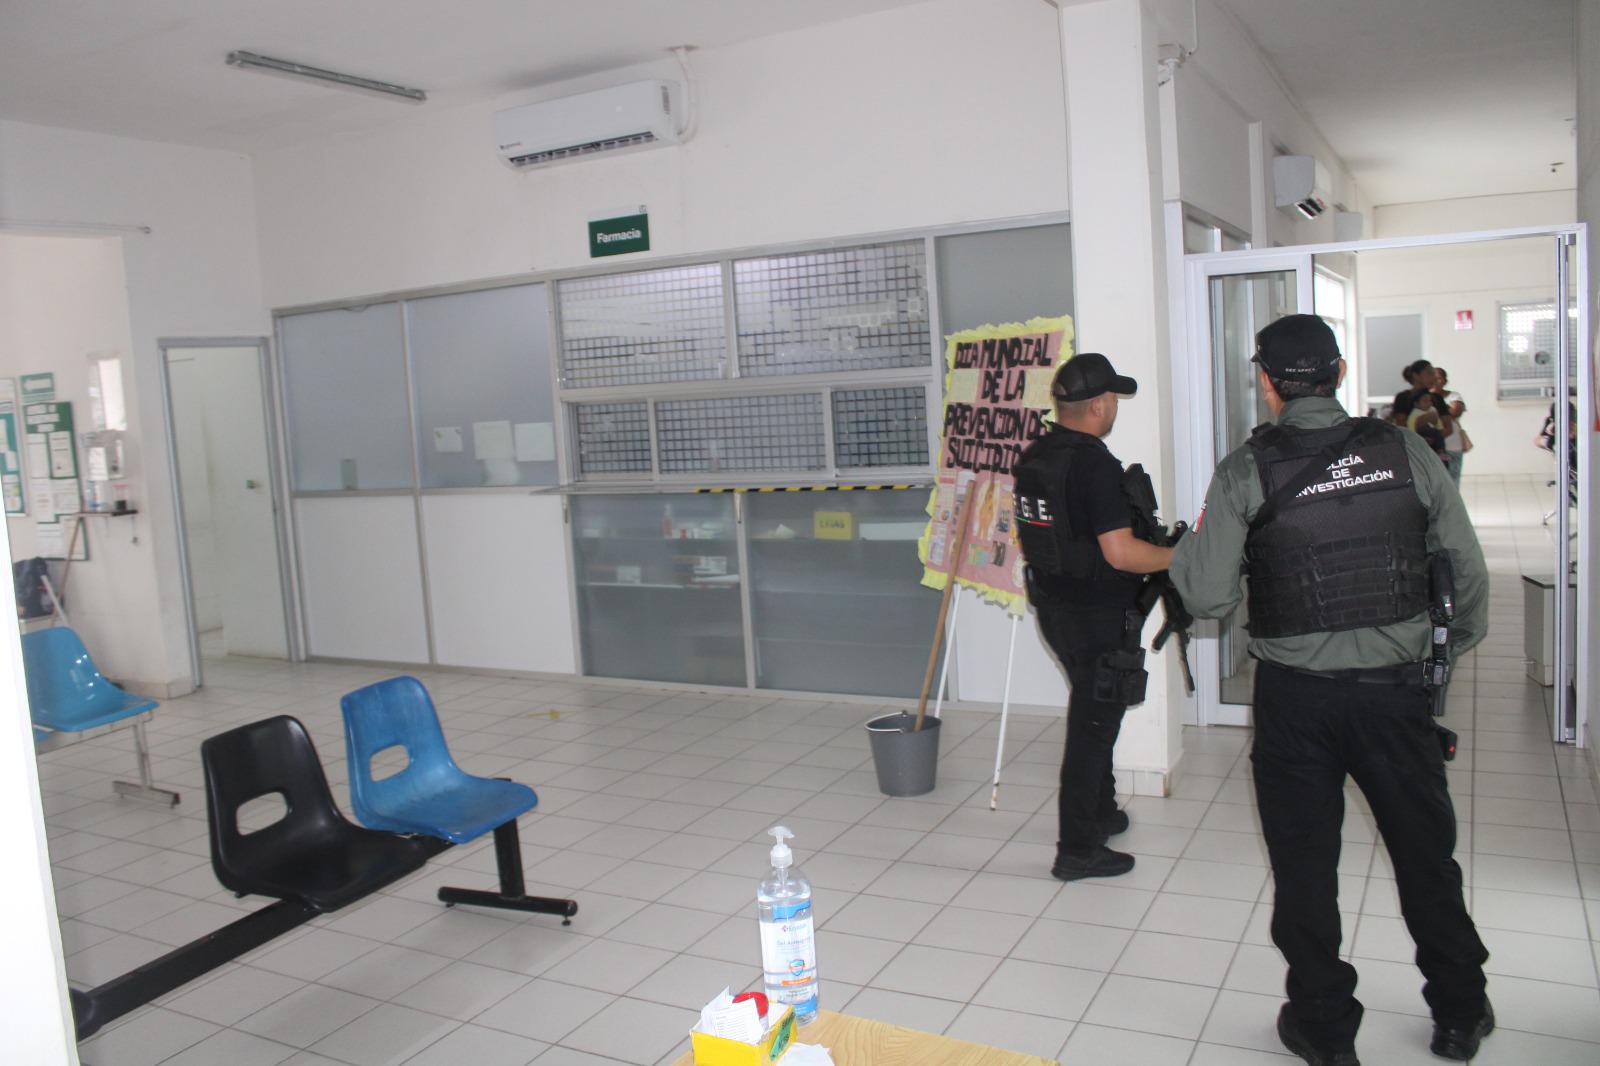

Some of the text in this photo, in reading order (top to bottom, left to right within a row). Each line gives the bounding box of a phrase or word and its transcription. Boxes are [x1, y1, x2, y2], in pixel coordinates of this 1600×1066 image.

[597, 229, 641, 244] Farmacia
[954, 333, 1052, 370] DIA MUNDIAL
[981, 369, 1026, 404] DE LA
[943, 402, 1027, 441] PREVENCION
[1325, 454, 1364, 471] LICÍA
[1331, 468, 1351, 480] DE
[1295, 469, 1394, 498] NVESTIGACIÓN
